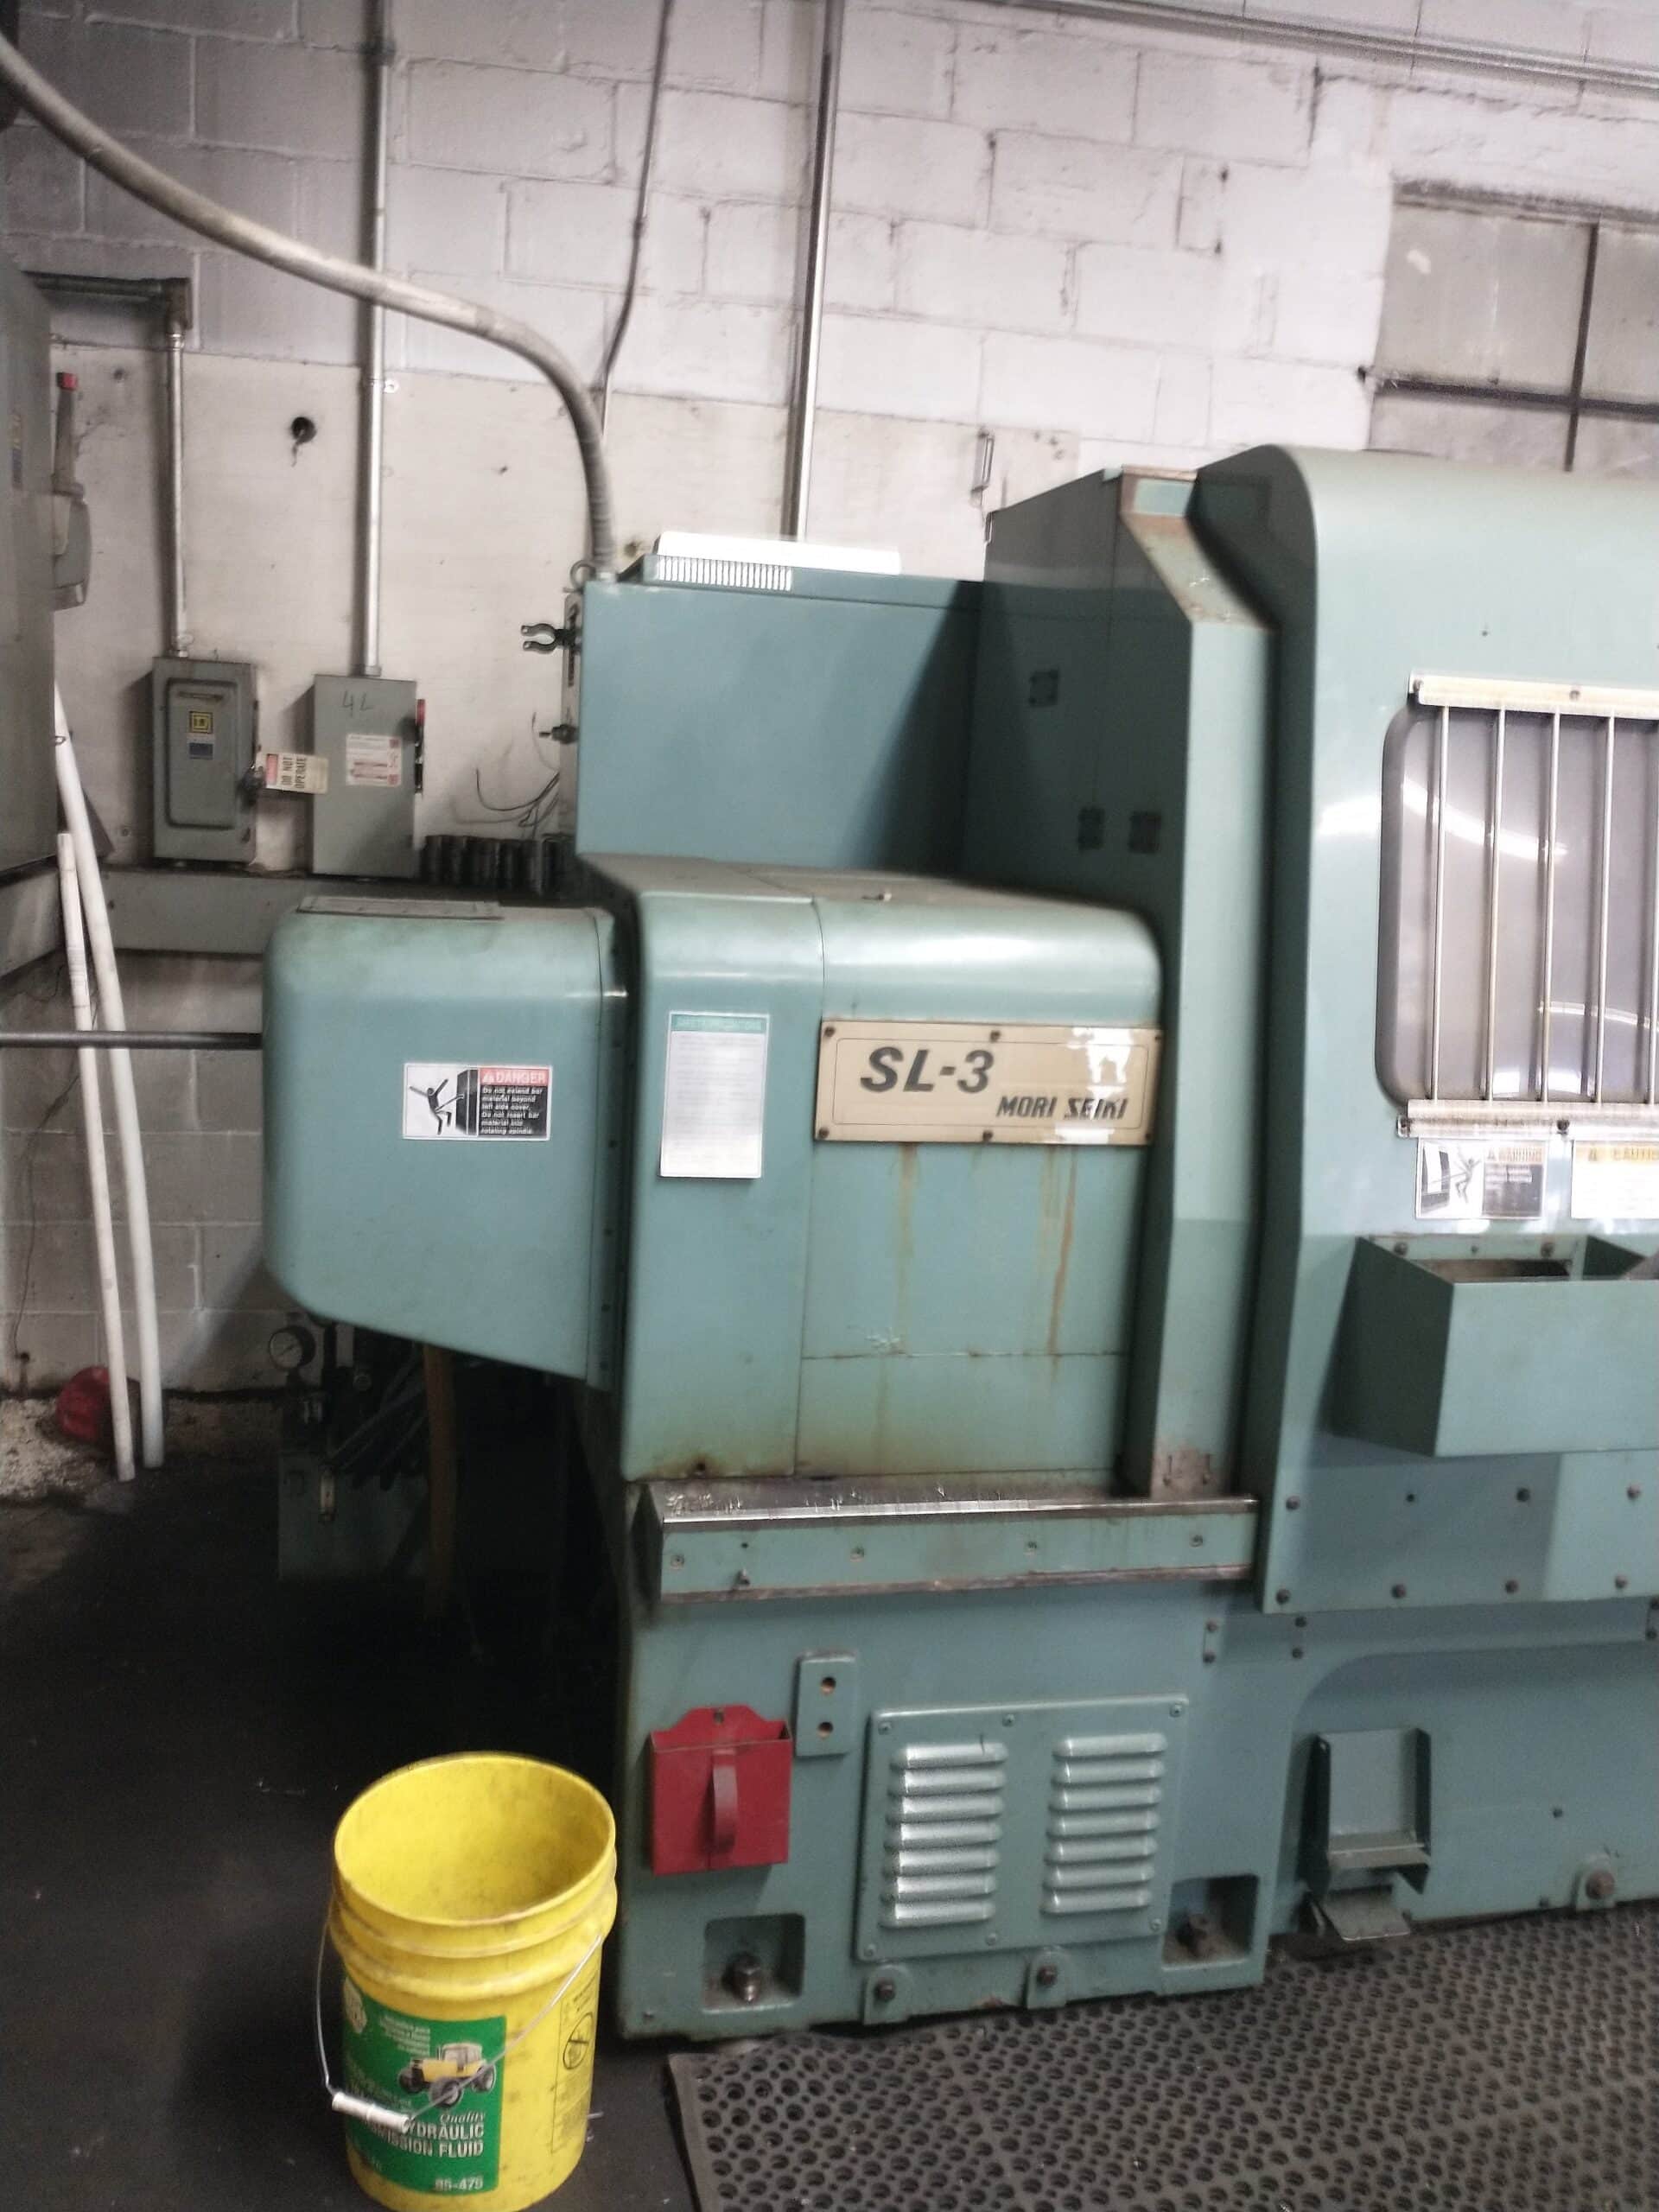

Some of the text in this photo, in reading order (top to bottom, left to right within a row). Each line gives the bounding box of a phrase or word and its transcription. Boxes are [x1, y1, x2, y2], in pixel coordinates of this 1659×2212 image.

[496, 1071, 546, 1084] DANGER
[860, 1046, 995, 1093] SL-3
[995, 1096, 1129, 1120] MORI SEIKI
[407, 2119, 485, 2141] YDRAULIC
[438, 2139, 484, 2158] FLUID
